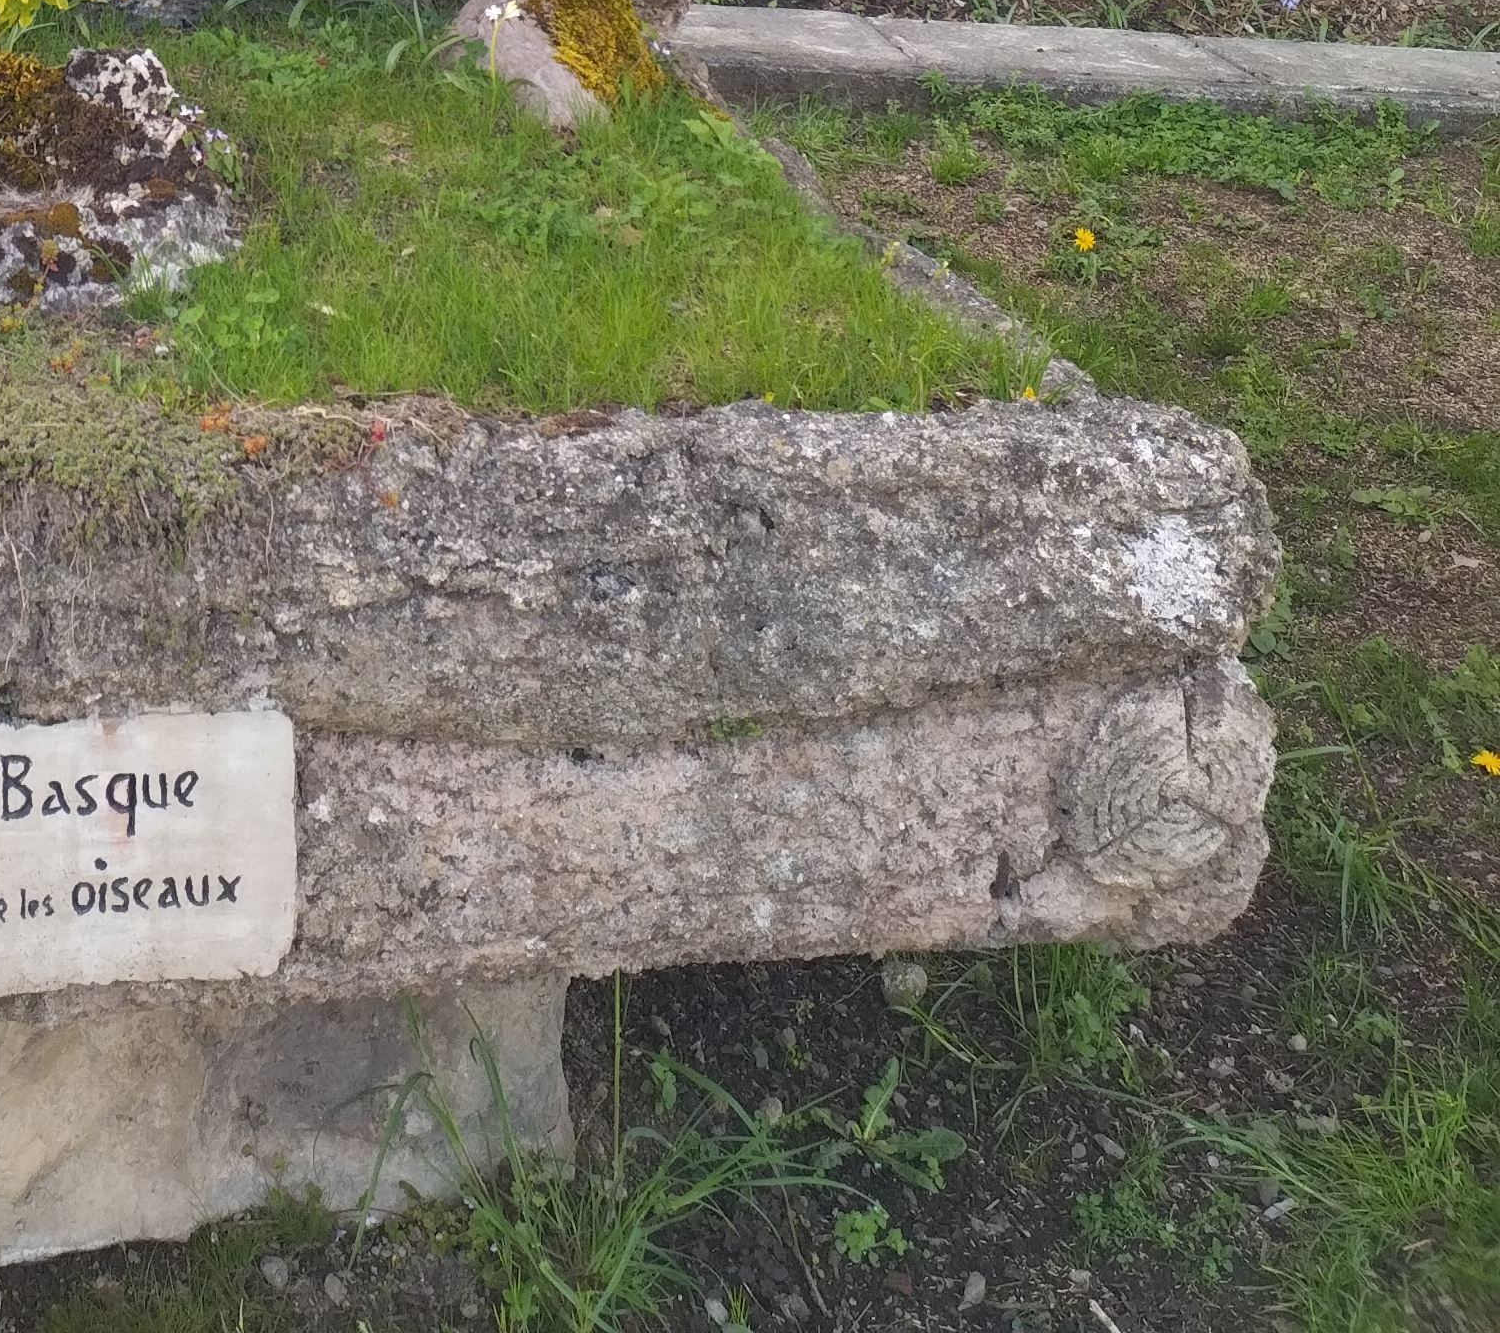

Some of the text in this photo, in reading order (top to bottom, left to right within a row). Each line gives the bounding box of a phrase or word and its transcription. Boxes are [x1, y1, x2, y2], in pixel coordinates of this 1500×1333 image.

[0, 753, 200, 837] Basque
[20, 888, 56, 921] les
[71, 858, 244, 916] oiseaux
